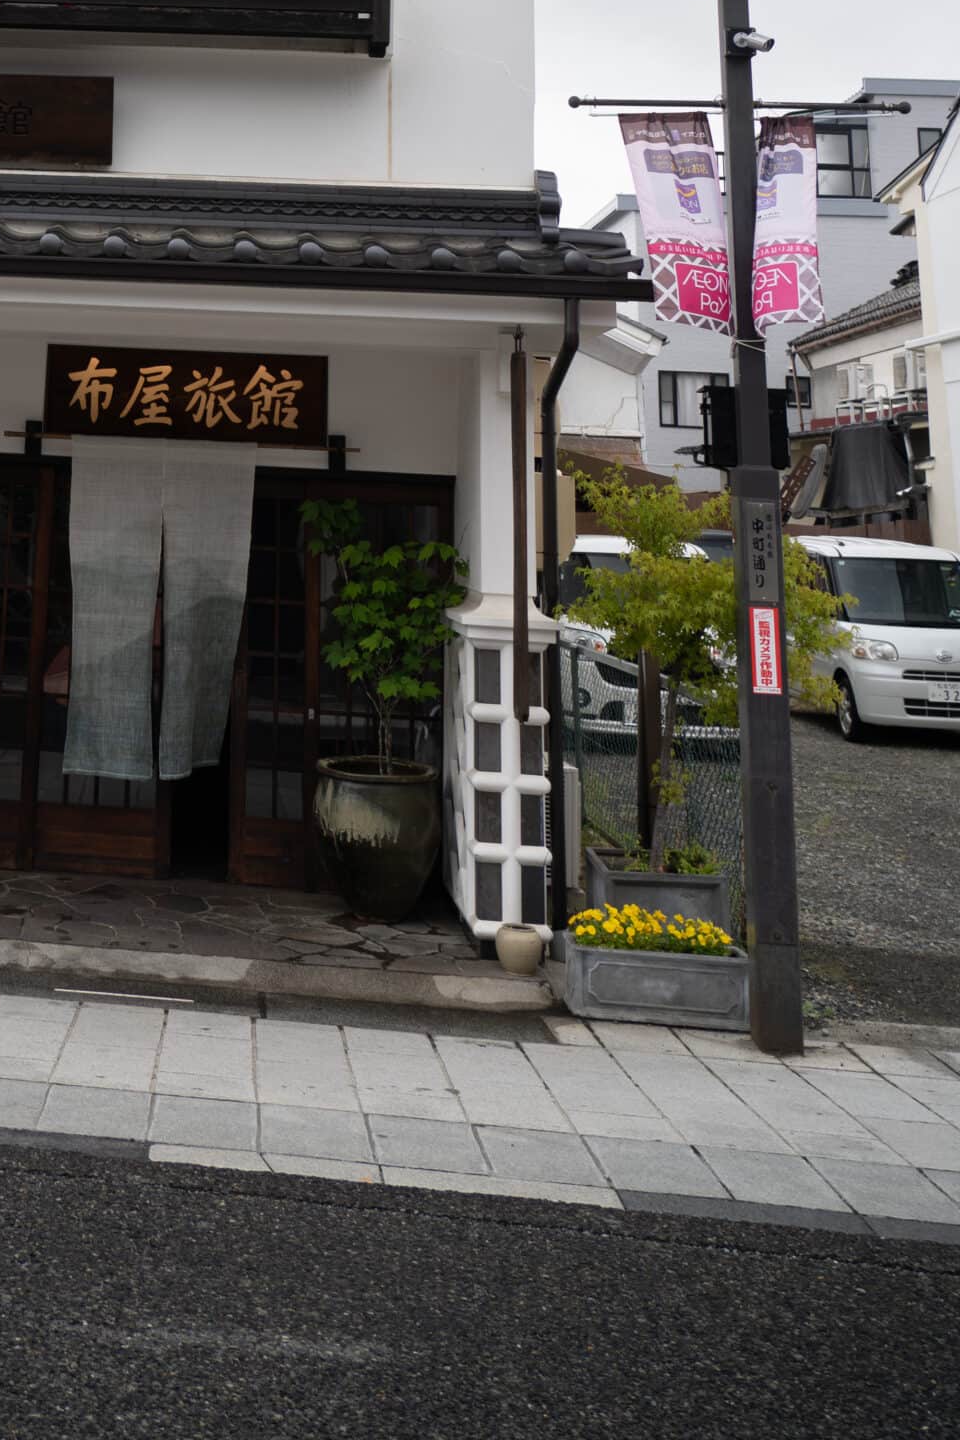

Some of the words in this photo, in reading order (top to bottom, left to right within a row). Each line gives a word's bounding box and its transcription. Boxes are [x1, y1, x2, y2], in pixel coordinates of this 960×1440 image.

[700, 292, 728, 315] Pay
[67, 357, 304, 430] 布屋旅館
[751, 518, 767, 588] 中町通り
[758, 620, 773, 687] 監視カメラ作動中
